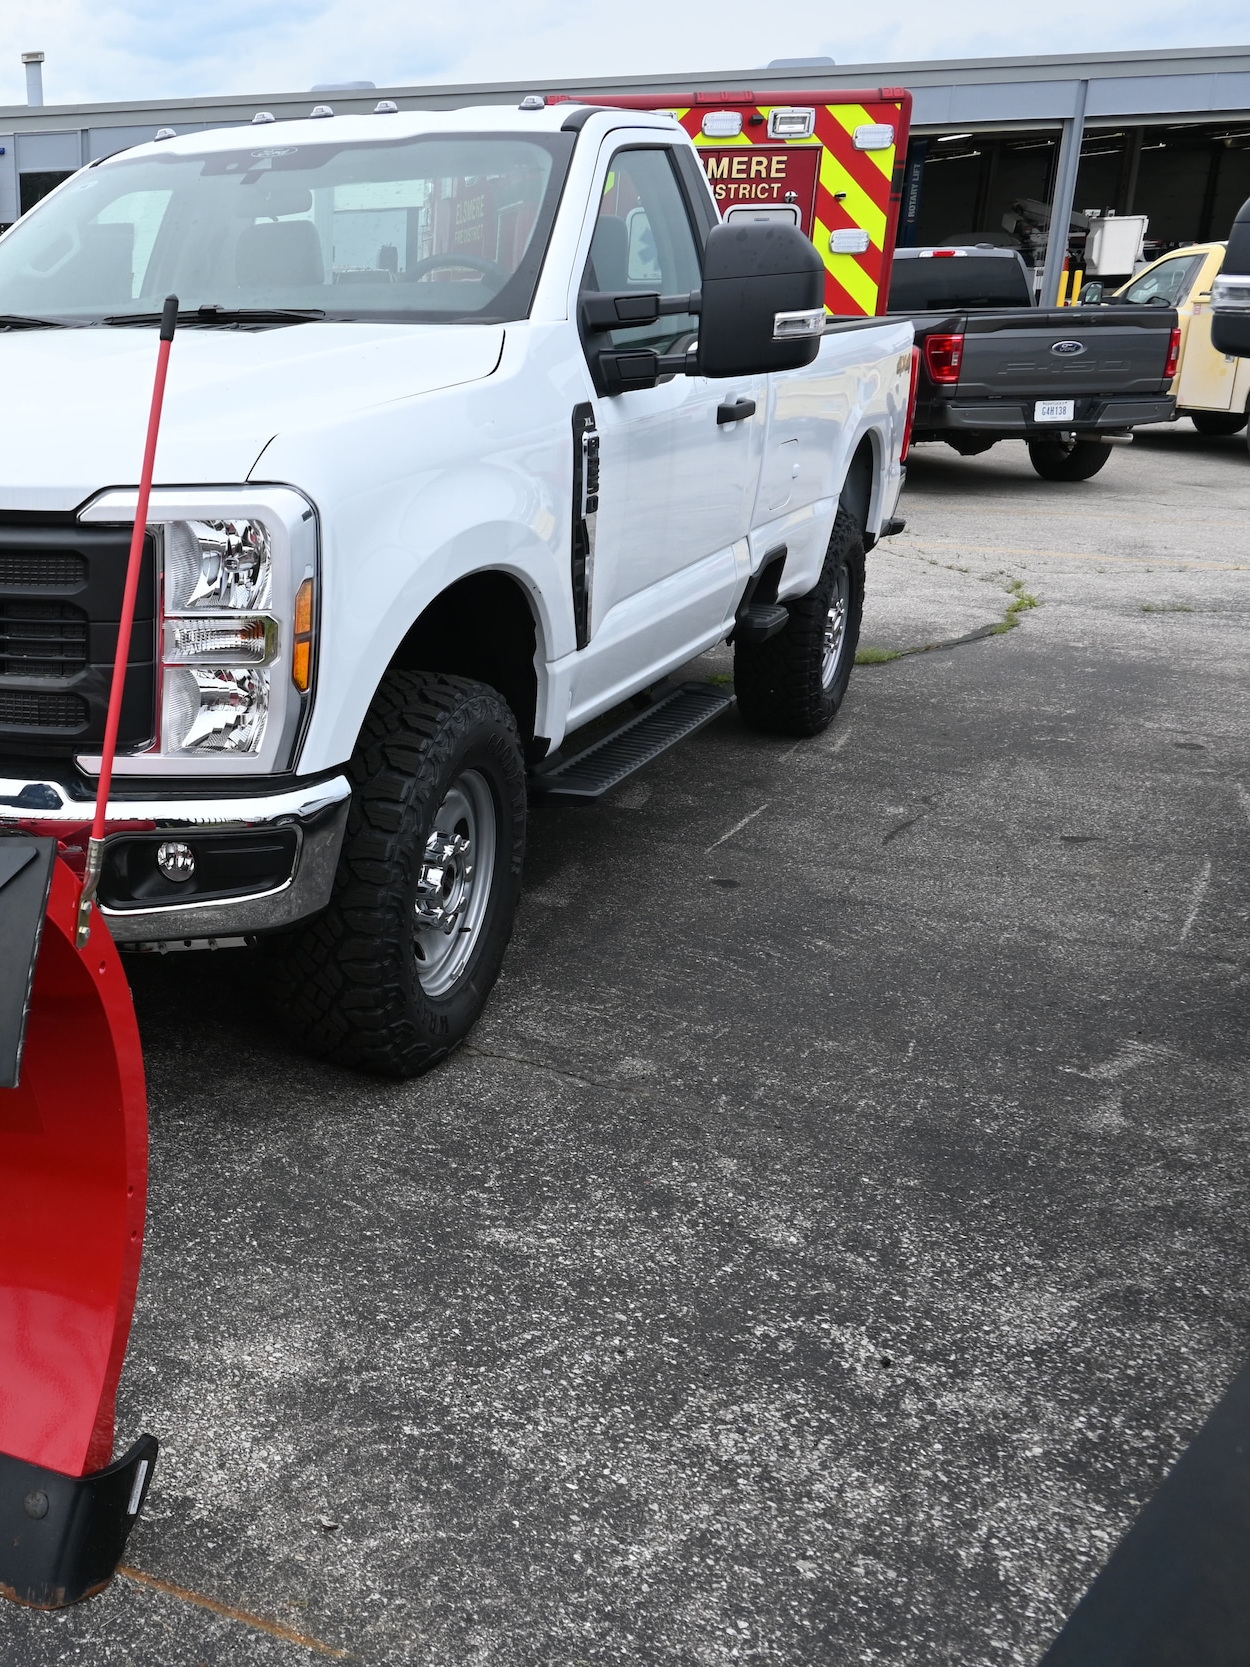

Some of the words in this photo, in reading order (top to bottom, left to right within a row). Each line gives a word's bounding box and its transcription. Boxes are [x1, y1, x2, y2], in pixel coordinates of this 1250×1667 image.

[699, 156, 788, 179] MERE
[912, 163, 921, 181] LIFT
[711, 183, 781, 199] STRICT
[908, 183, 918, 217] ROTARY
[997, 360, 1130, 375] F-150
[1041, 405, 1067, 416] G4H138
